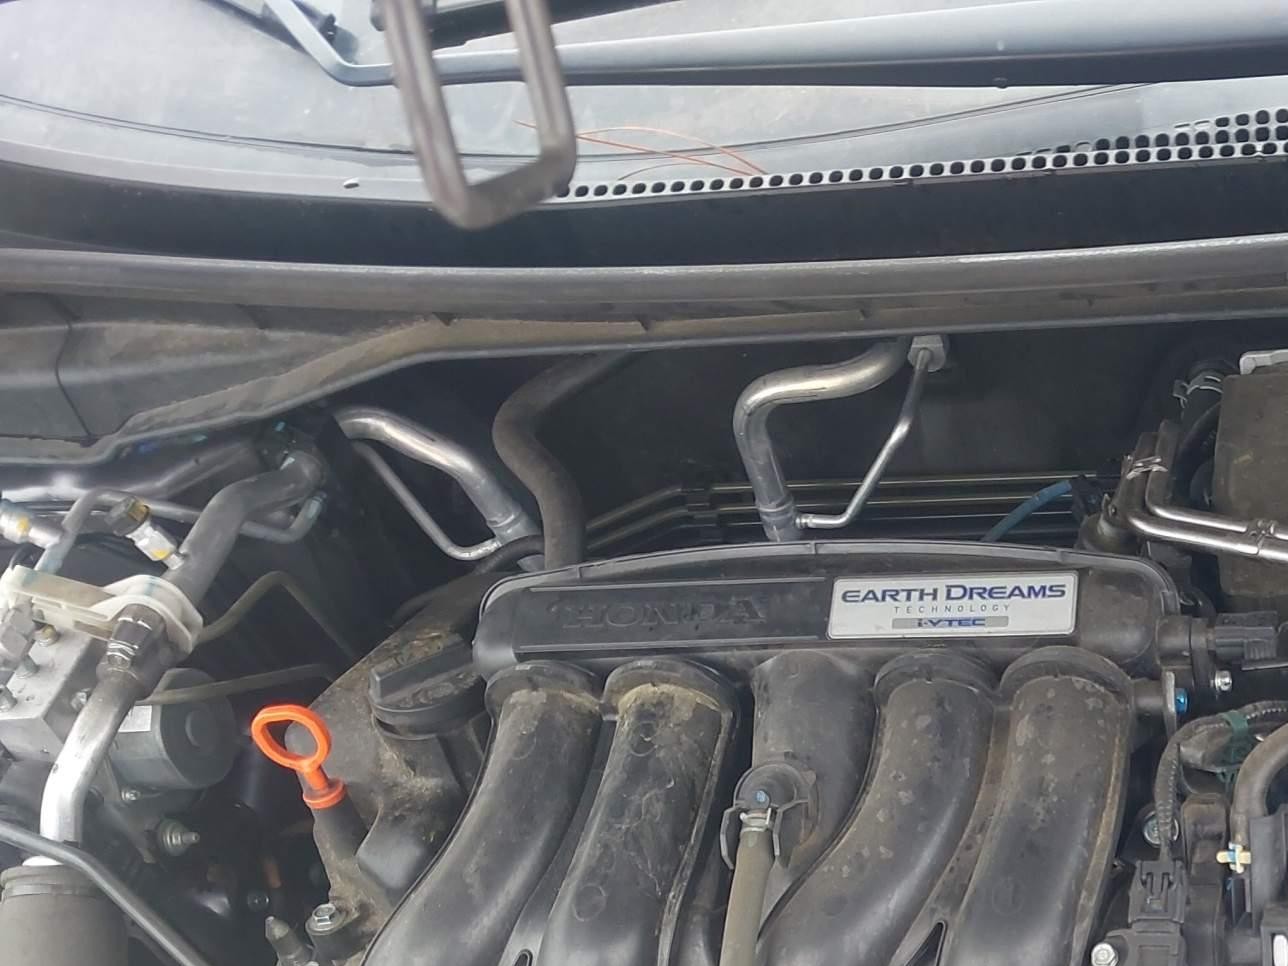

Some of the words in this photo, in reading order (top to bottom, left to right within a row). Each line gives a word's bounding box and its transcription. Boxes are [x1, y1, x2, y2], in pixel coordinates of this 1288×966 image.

[841, 587, 938, 603] EARTH
[944, 584, 1066, 601] DREAMS
[560, 596, 767, 628] HONDA
[894, 604, 1010, 614] TECHNOLOGY
[917, 617, 986, 628] i-VTEC
